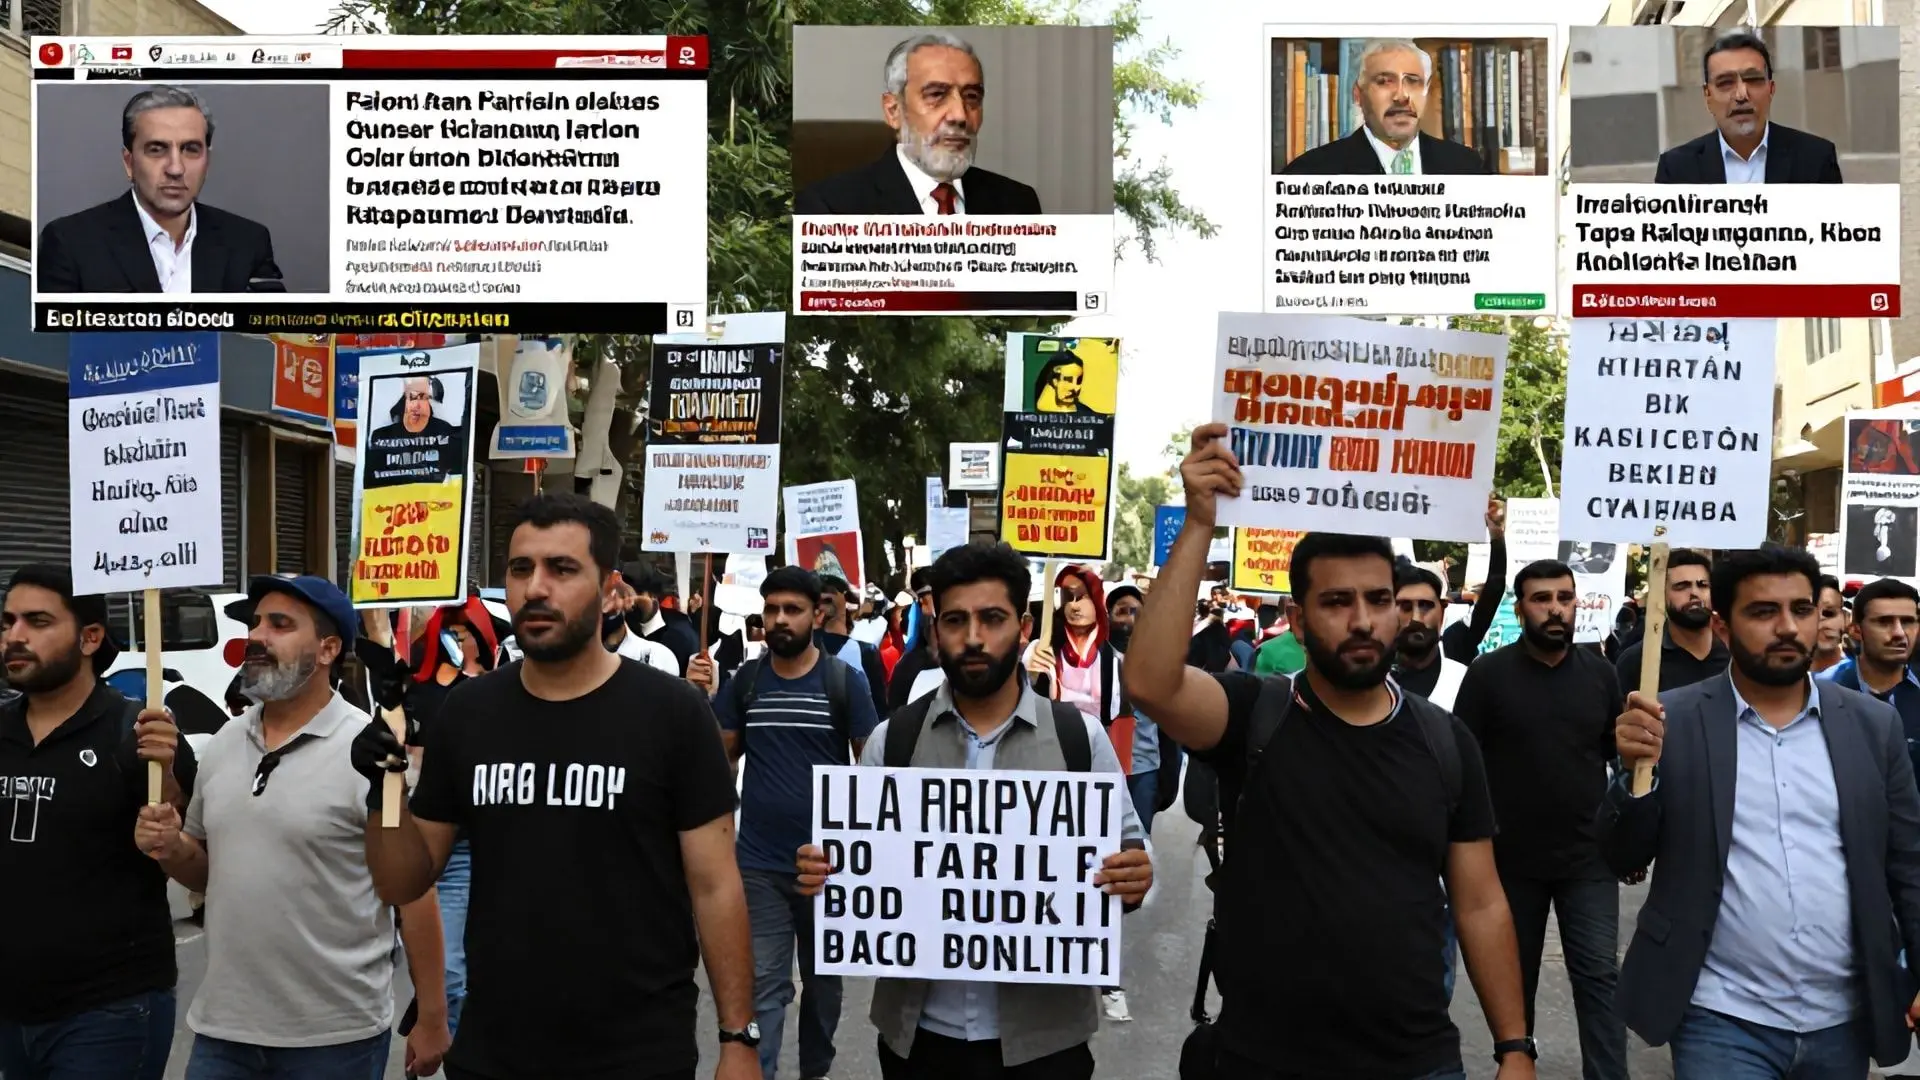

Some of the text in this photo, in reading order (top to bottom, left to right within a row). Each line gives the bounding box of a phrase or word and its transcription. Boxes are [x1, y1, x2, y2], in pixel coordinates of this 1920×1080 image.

[820, 773, 902, 833] LLA
[823, 883, 903, 920] BOD
[822, 928, 917, 967] BACO
